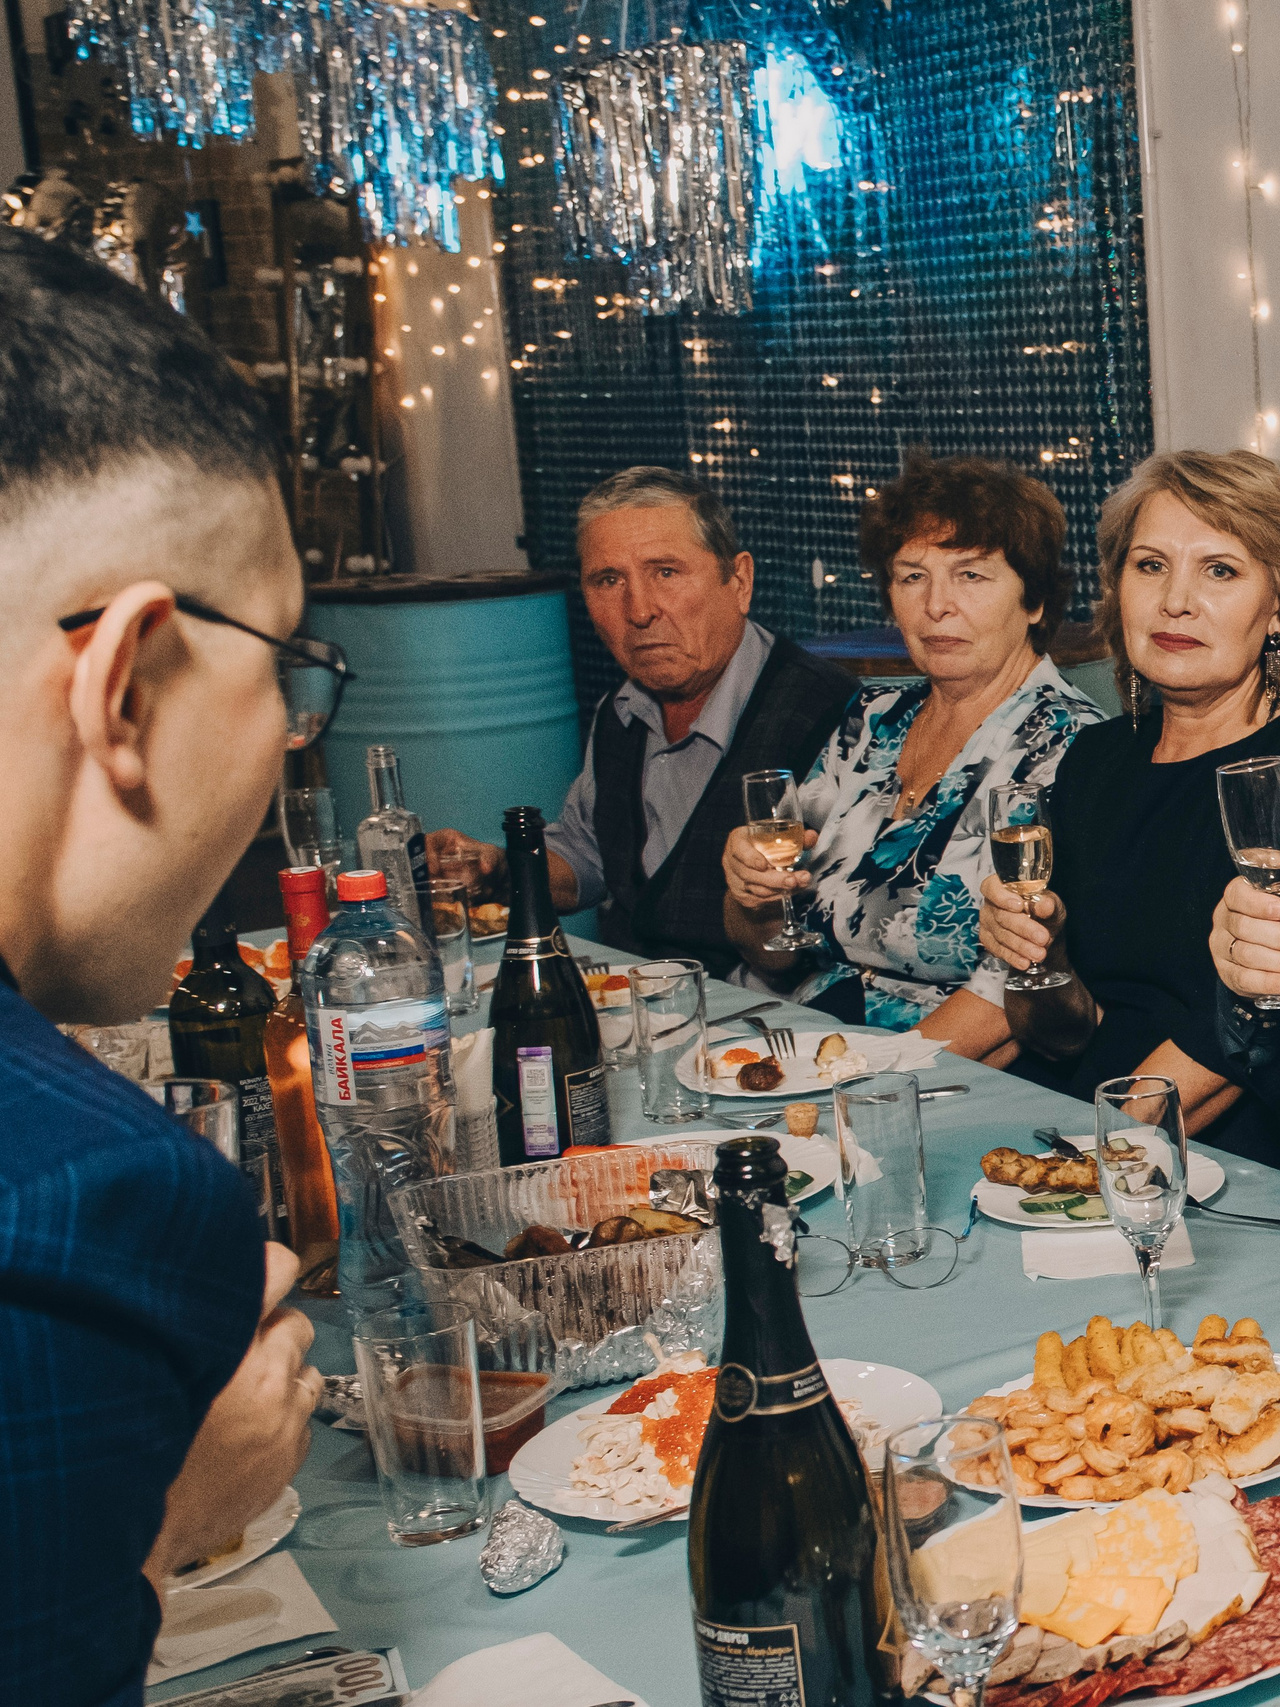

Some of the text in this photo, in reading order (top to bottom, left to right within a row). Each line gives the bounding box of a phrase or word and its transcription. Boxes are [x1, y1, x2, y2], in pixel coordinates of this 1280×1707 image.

[331, 1017, 351, 1100] БАЙКАЛА
[253, 1103, 272, 1113] КАХЕ
[334, 1657, 386, 1697] 100
